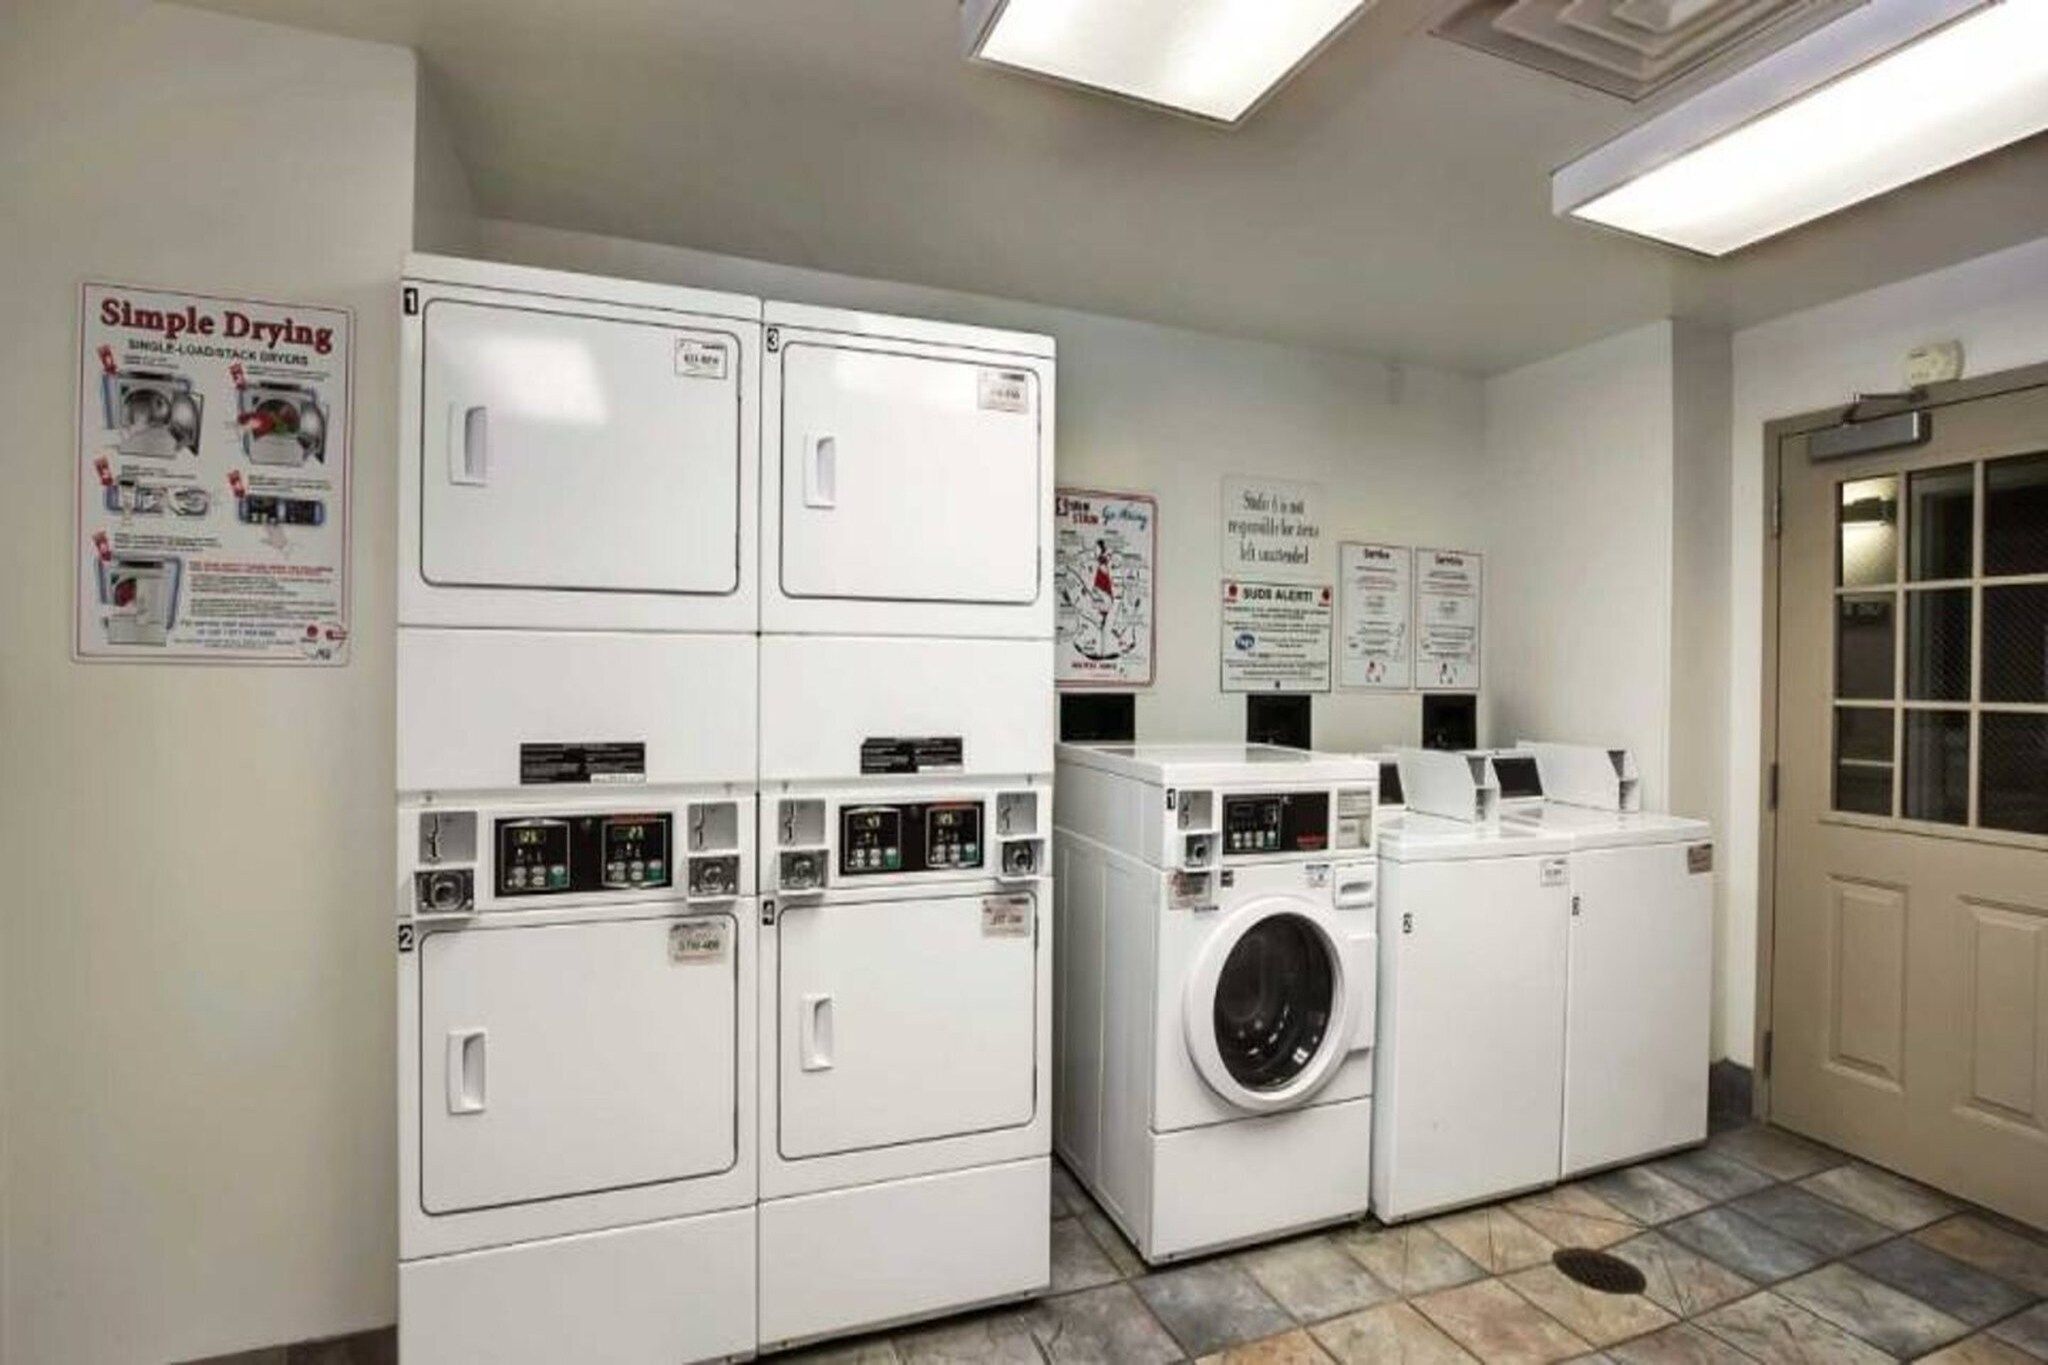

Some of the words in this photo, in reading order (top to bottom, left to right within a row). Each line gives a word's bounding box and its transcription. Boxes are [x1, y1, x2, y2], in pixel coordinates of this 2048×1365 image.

[101, 299, 214, 339] Simple
[222, 311, 333, 354] Drying
[259, 350, 309, 366] DRYERS
[1243, 587, 1272, 600] SUDS
[399, 926, 413, 950] 2
